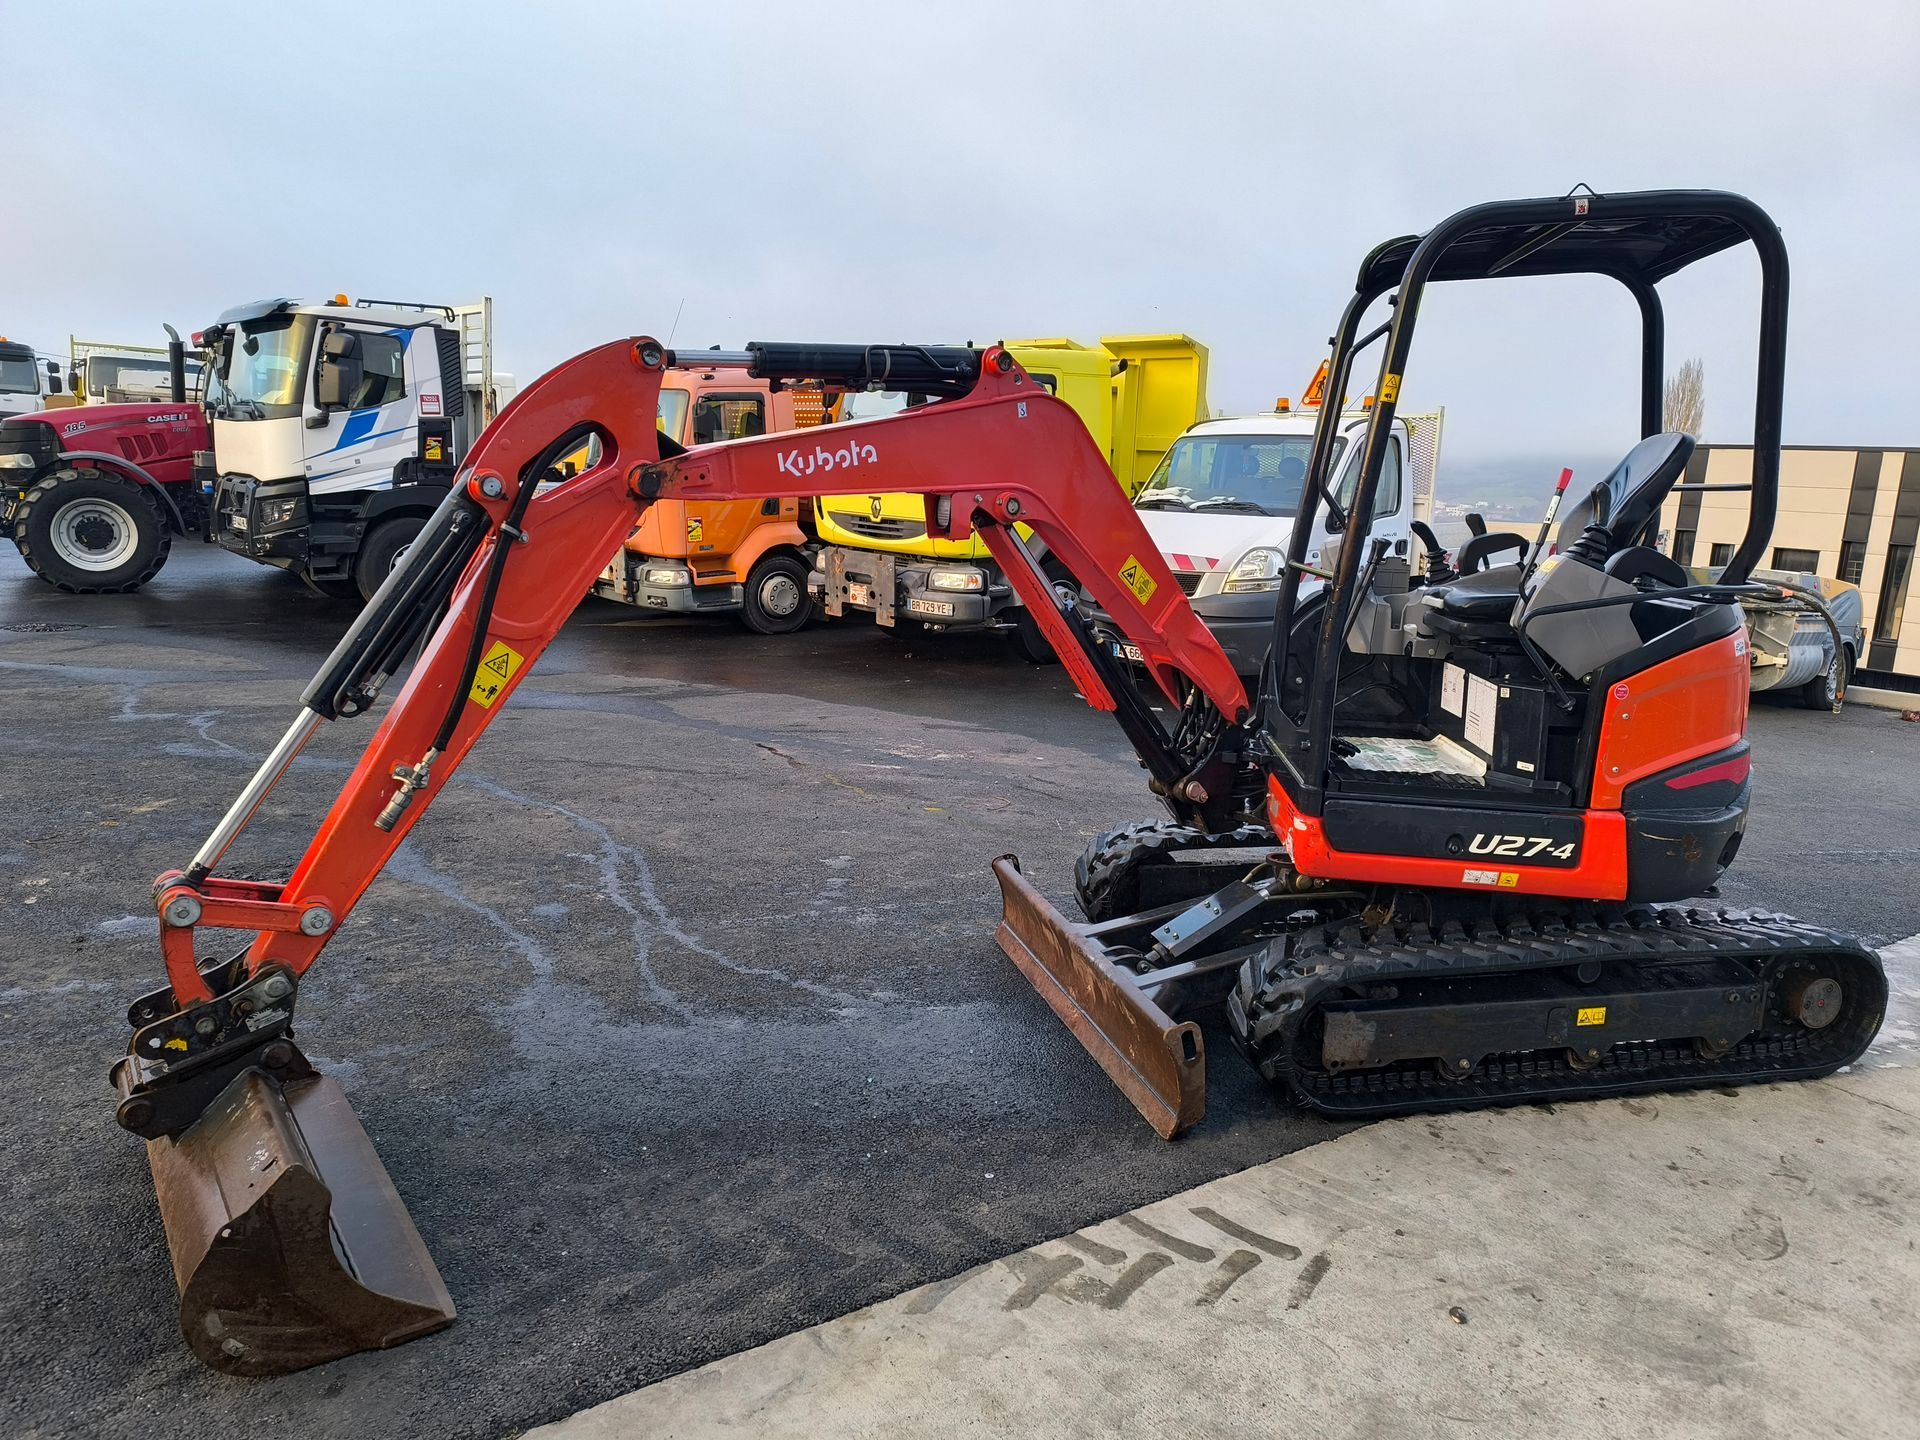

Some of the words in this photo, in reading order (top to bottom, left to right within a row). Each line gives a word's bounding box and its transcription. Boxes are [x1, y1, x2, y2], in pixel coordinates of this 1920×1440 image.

[65, 421, 86, 432] 185
[147, 414, 177, 423] CASE
[777, 440, 878, 476] Kubota
[1468, 833, 1576, 860] U27-4
